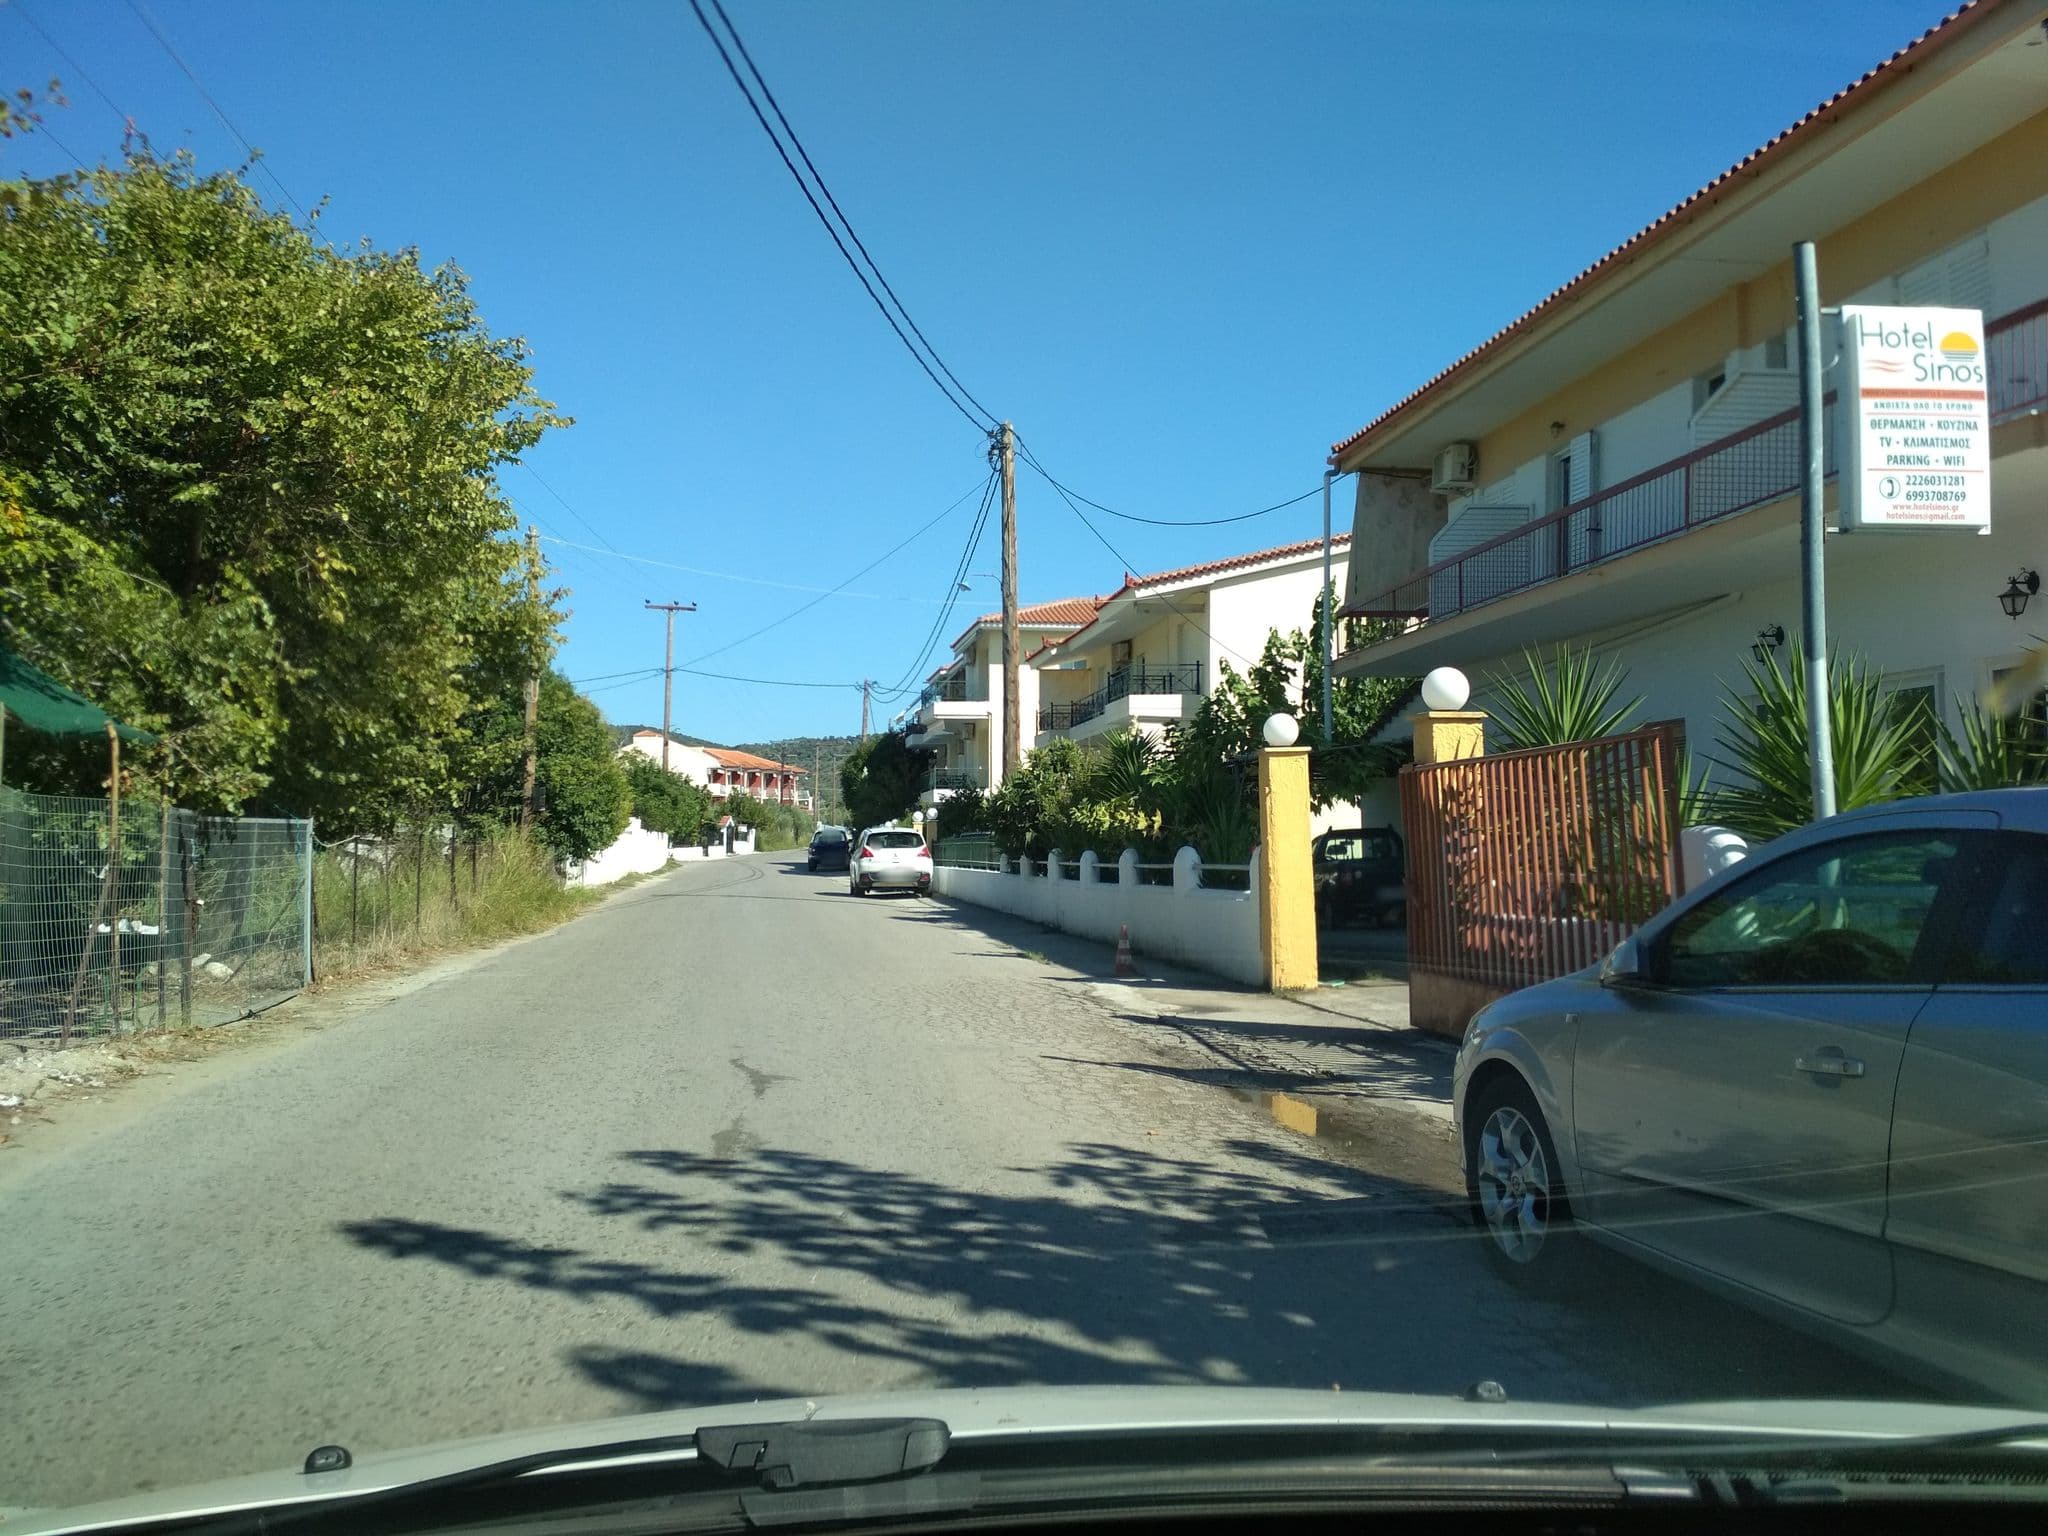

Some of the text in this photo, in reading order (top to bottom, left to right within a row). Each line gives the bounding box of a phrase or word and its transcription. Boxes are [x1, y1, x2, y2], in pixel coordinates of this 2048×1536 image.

[1859, 314, 1933, 349] Hotel
[1913, 353, 1983, 383] Sinos
[1870, 418, 1979, 431] ΘΕΡΜΑΝΣΗ ΚΟΥΖΙΝΑ
[1880, 437, 1971, 449] TV ΚΛΙΜΑΤΙΣΜΟΣ
[1886, 455, 1965, 467] PARKING WIFI
[1905, 475, 1965, 487] 2226031281
[1905, 491, 1966, 502] 6993708769
